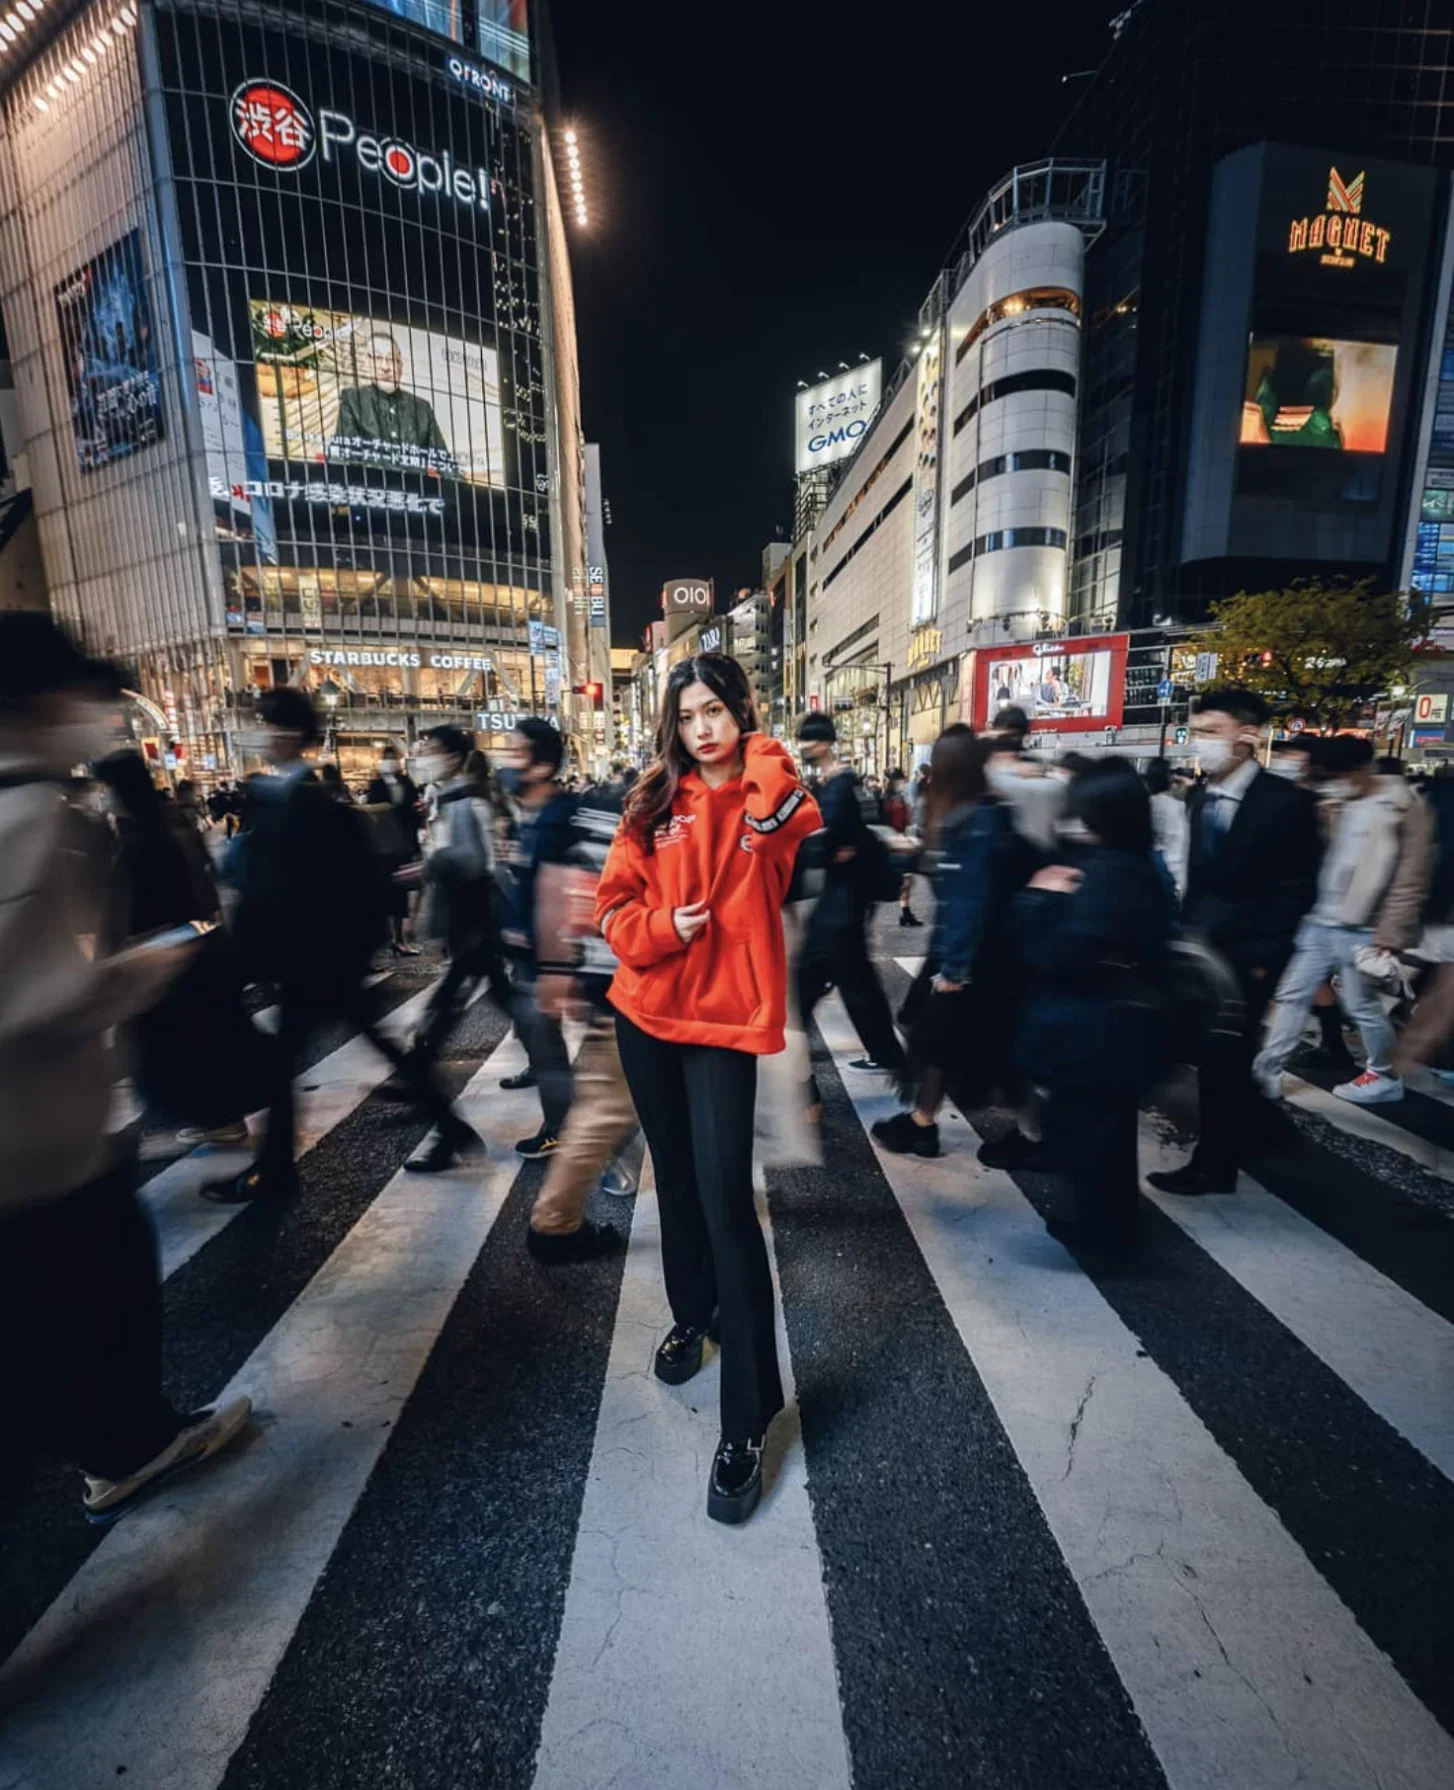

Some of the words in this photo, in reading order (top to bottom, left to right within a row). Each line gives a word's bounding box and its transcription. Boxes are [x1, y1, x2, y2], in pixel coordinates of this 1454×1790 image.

[233, 98, 312, 151] 渋谷
[319, 107, 490, 211] People!
[1288, 214, 1391, 264] MAGNET
[807, 419, 868, 452] GMO
[310, 651, 420, 667] STARBUCKS
[430, 655, 492, 670] COFFEE
[477, 713, 561, 732] TSUA
